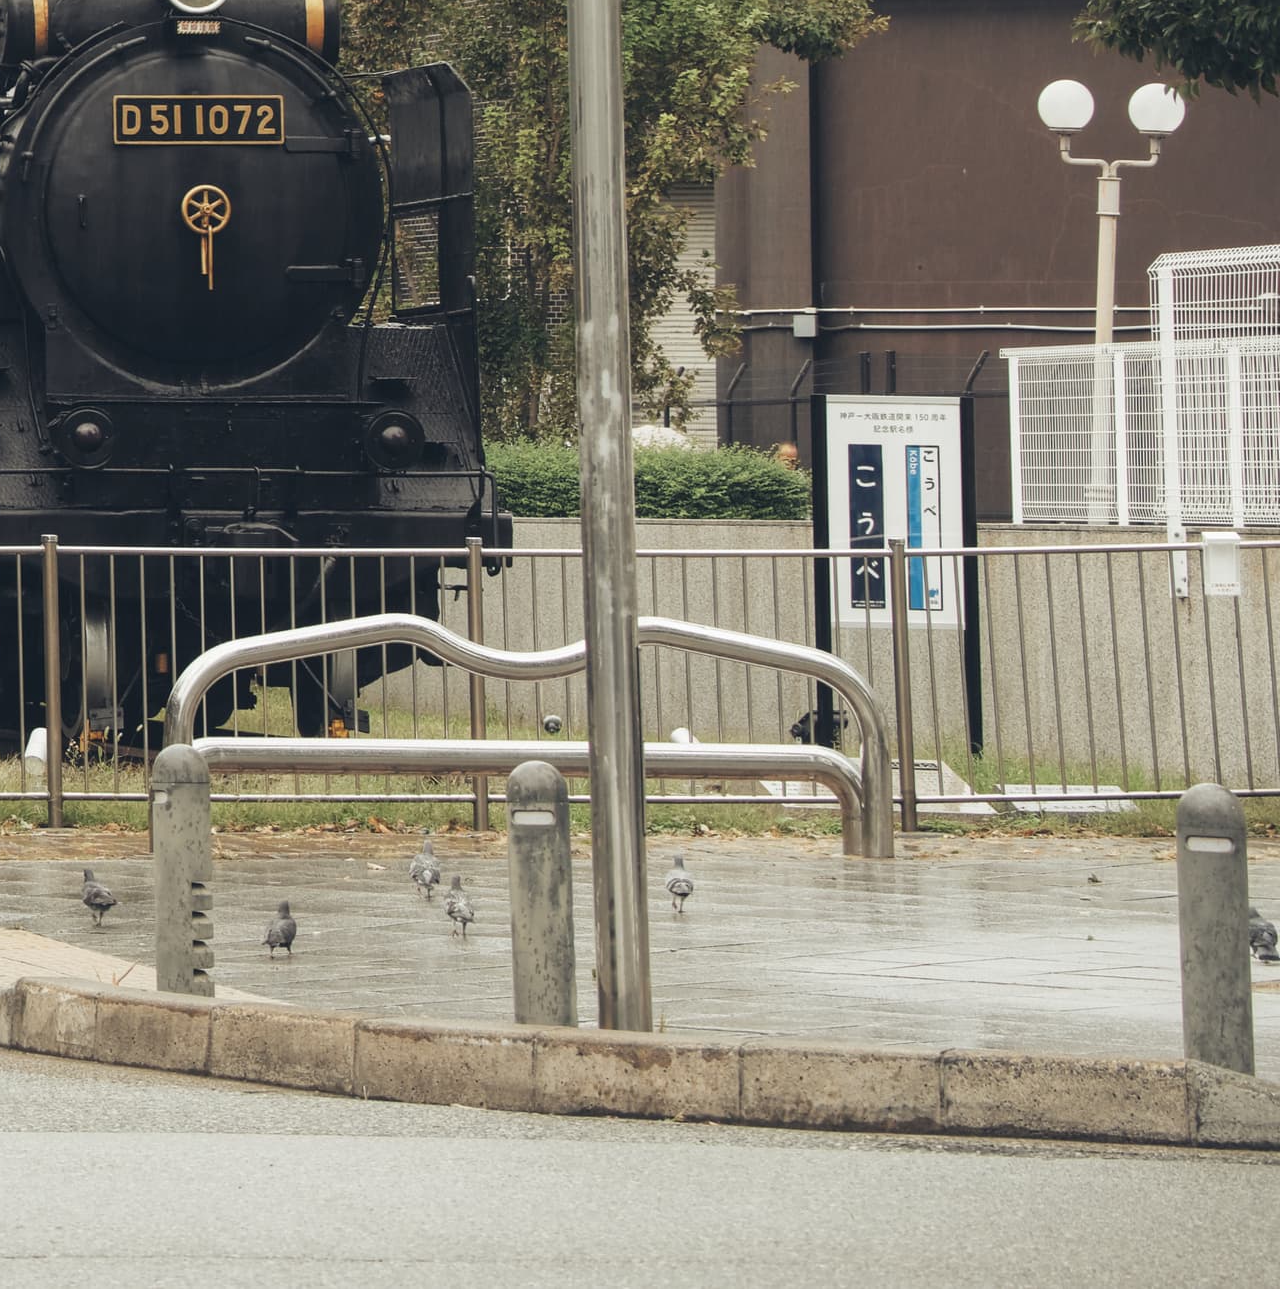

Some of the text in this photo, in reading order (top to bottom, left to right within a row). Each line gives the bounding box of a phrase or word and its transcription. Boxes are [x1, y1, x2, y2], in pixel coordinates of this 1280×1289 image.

[195, 104, 276, 135] 1072
[915, 413, 929, 421] 150
[923, 450, 937, 516] こうべ
[856, 465, 880, 579] こうべ
